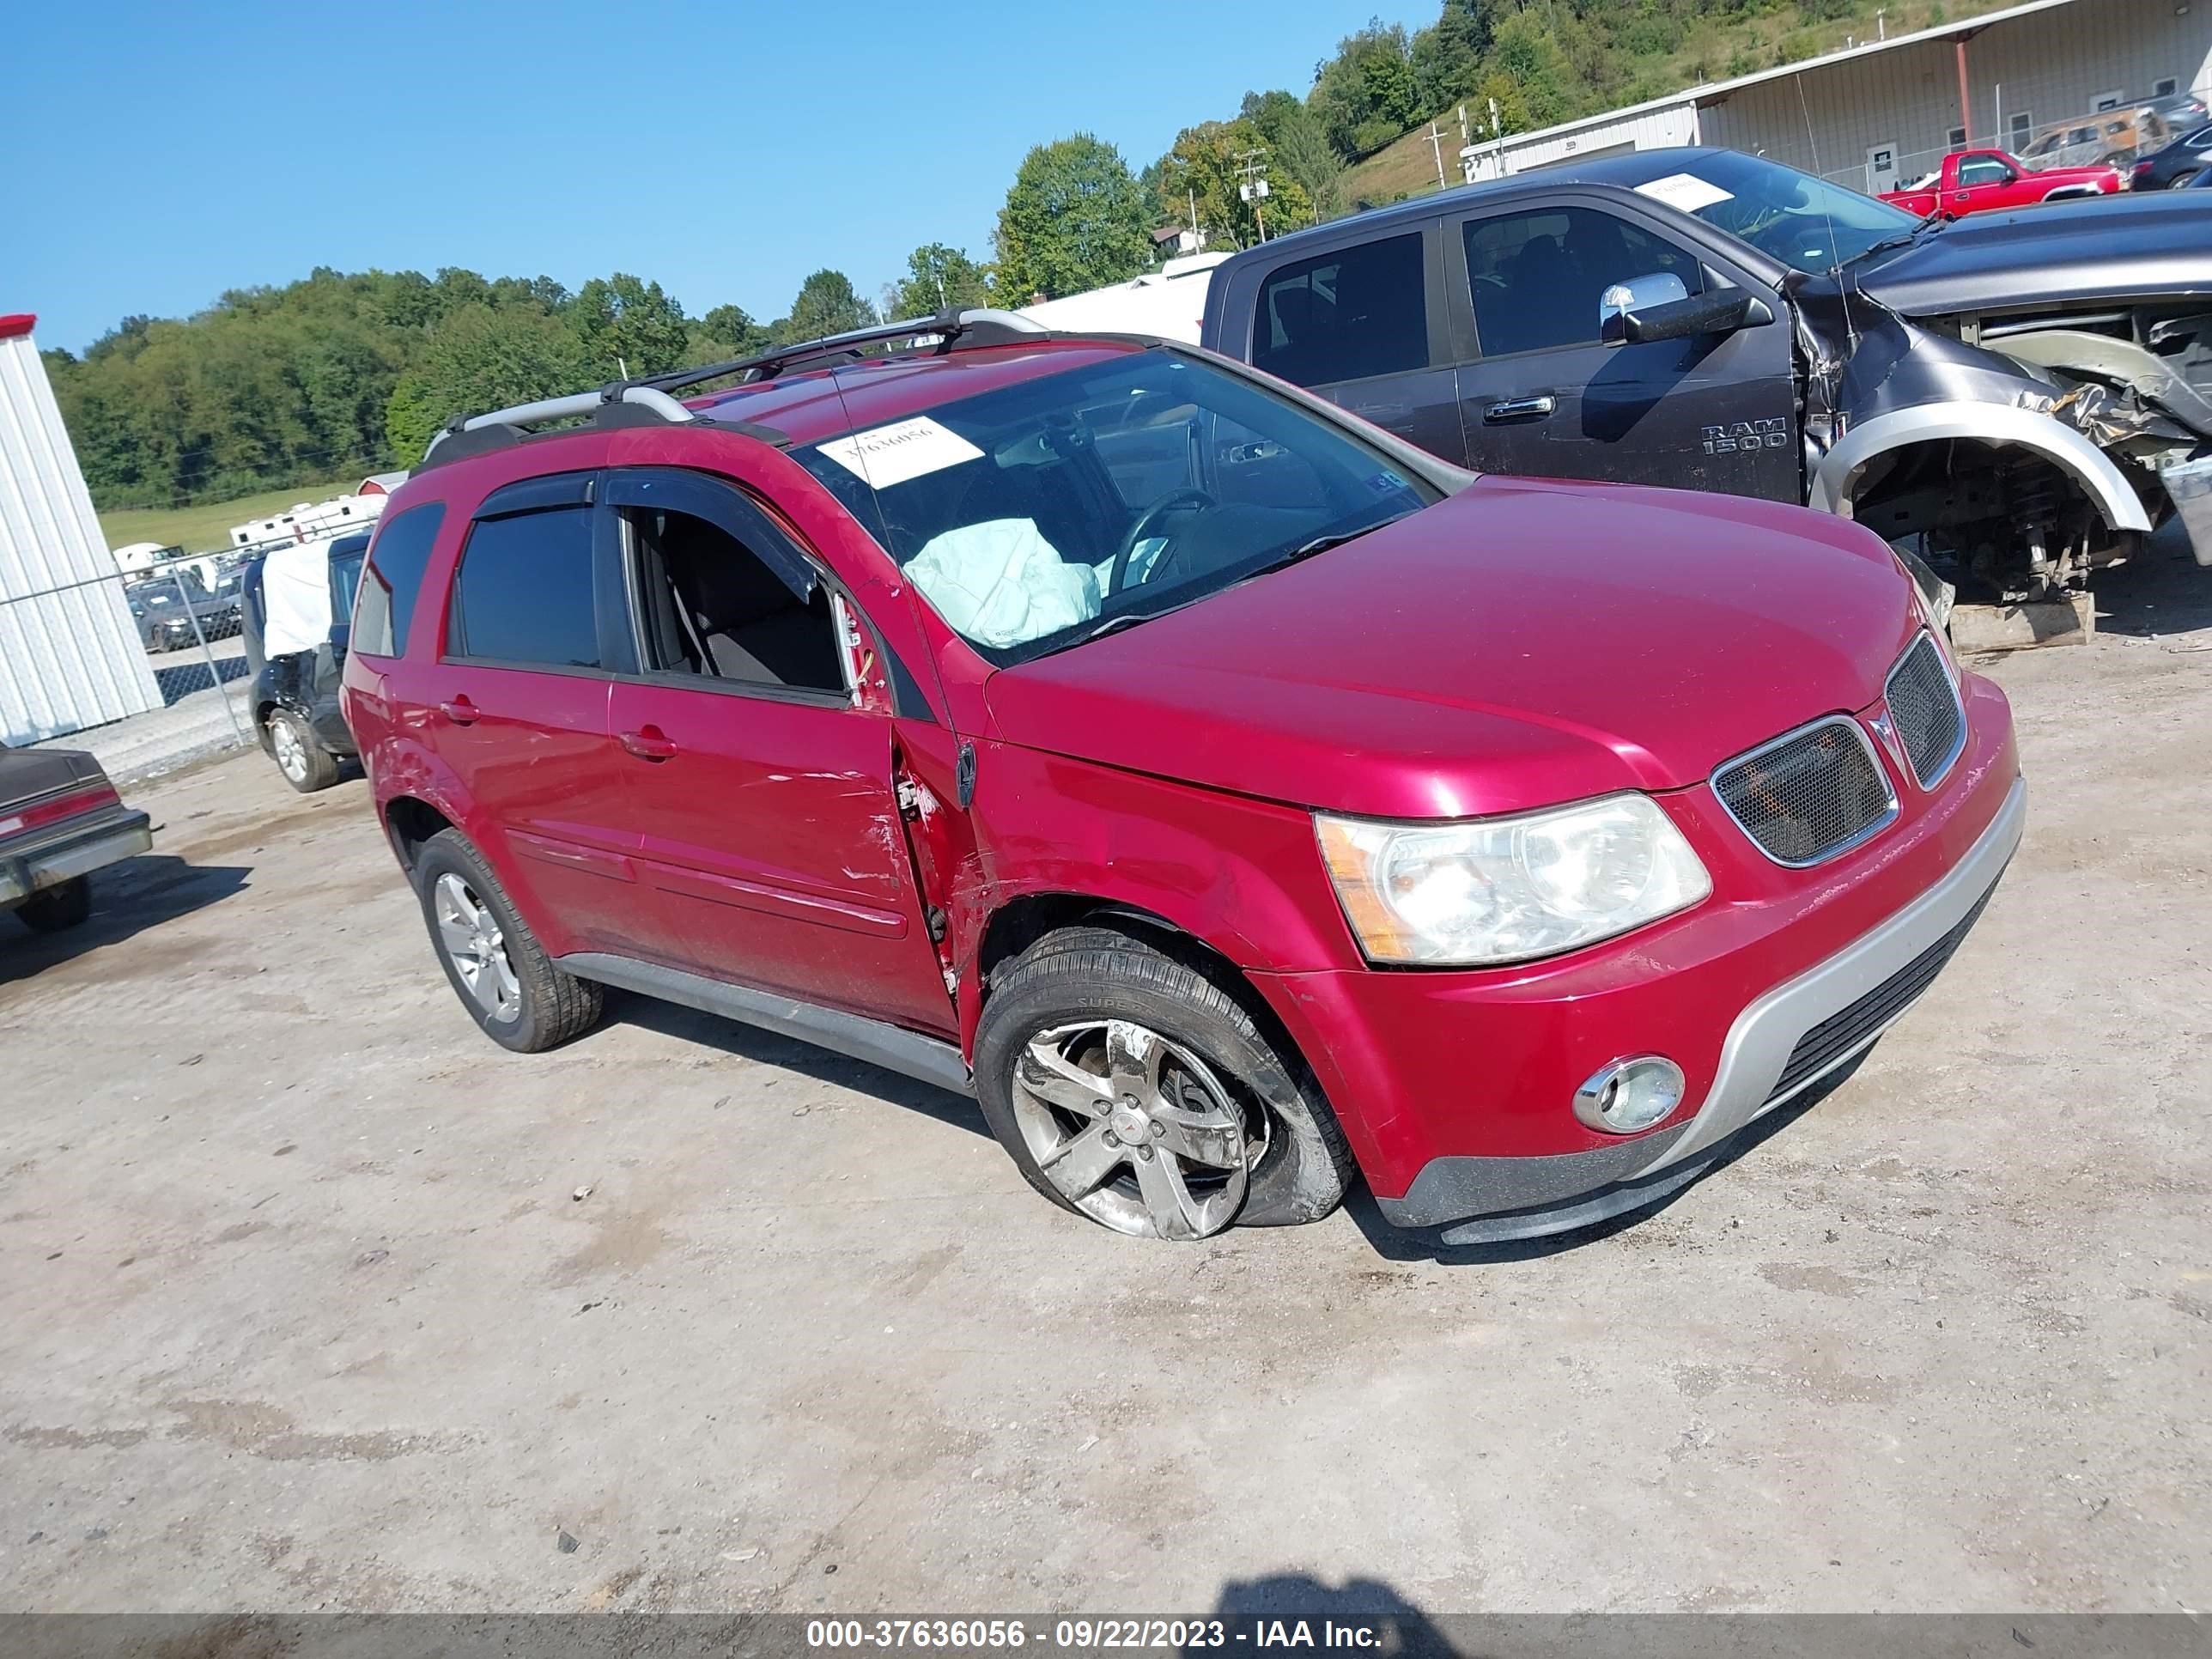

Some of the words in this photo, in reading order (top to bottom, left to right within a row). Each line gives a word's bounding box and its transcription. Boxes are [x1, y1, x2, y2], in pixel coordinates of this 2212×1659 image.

[1700, 416, 1787, 441] RAM
[844, 428, 933, 460] 37636056
[1702, 432, 1787, 455] 1500
